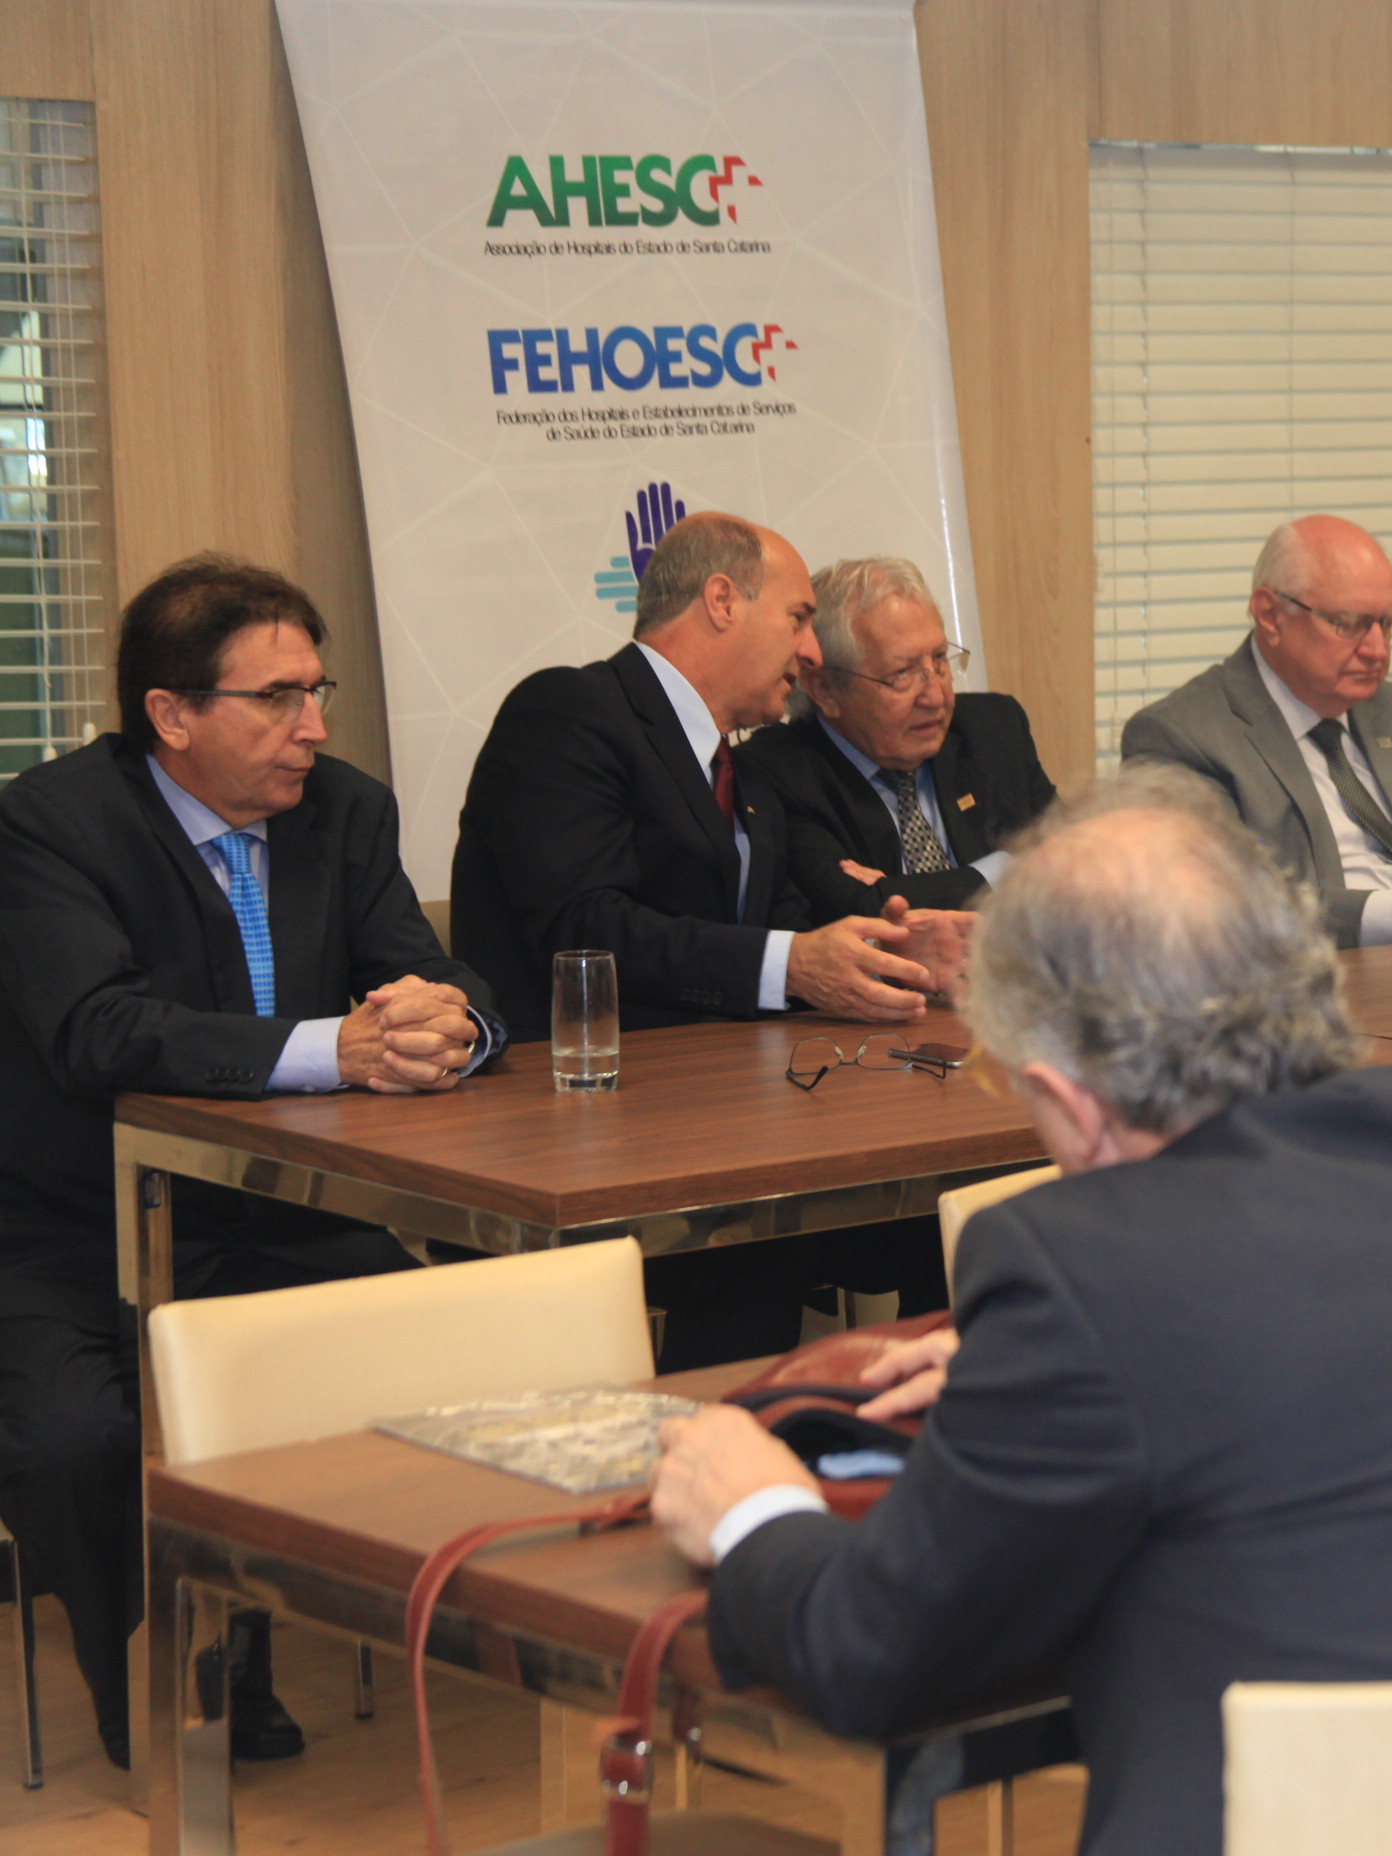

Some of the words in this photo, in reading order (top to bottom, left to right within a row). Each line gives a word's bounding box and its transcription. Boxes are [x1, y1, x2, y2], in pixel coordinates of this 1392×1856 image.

[486, 154, 721, 228] AHESC
[484, 240, 547, 258] Associação
[549, 240, 565, 255] de
[566, 240, 617, 257] Hospitais
[618, 240, 634, 255] do
[635, 239, 674, 255] Estado
[676, 240, 691, 254] de
[692, 239, 725, 254] Santa
[727, 238, 771, 254] Catarina
[486, 322, 763, 395] FEHOESC
[496, 408, 556, 427] Federação
[557, 408, 579, 423] dos
[581, 406, 630, 424] Hospitais
[632, 408, 641, 420] e
[642, 404, 735, 421] Estabelecimentos
[736, 402, 751, 417] de
[752, 400, 797, 417] Serviços
[546, 425, 562, 441] de
[563, 424, 601, 441] Saúde
[602, 424, 618, 439] do
[620, 423, 658, 439] Estado
[660, 422, 674, 437] de
[676, 421, 709, 436] Santa
[710, 419, 756, 435] Catarina
